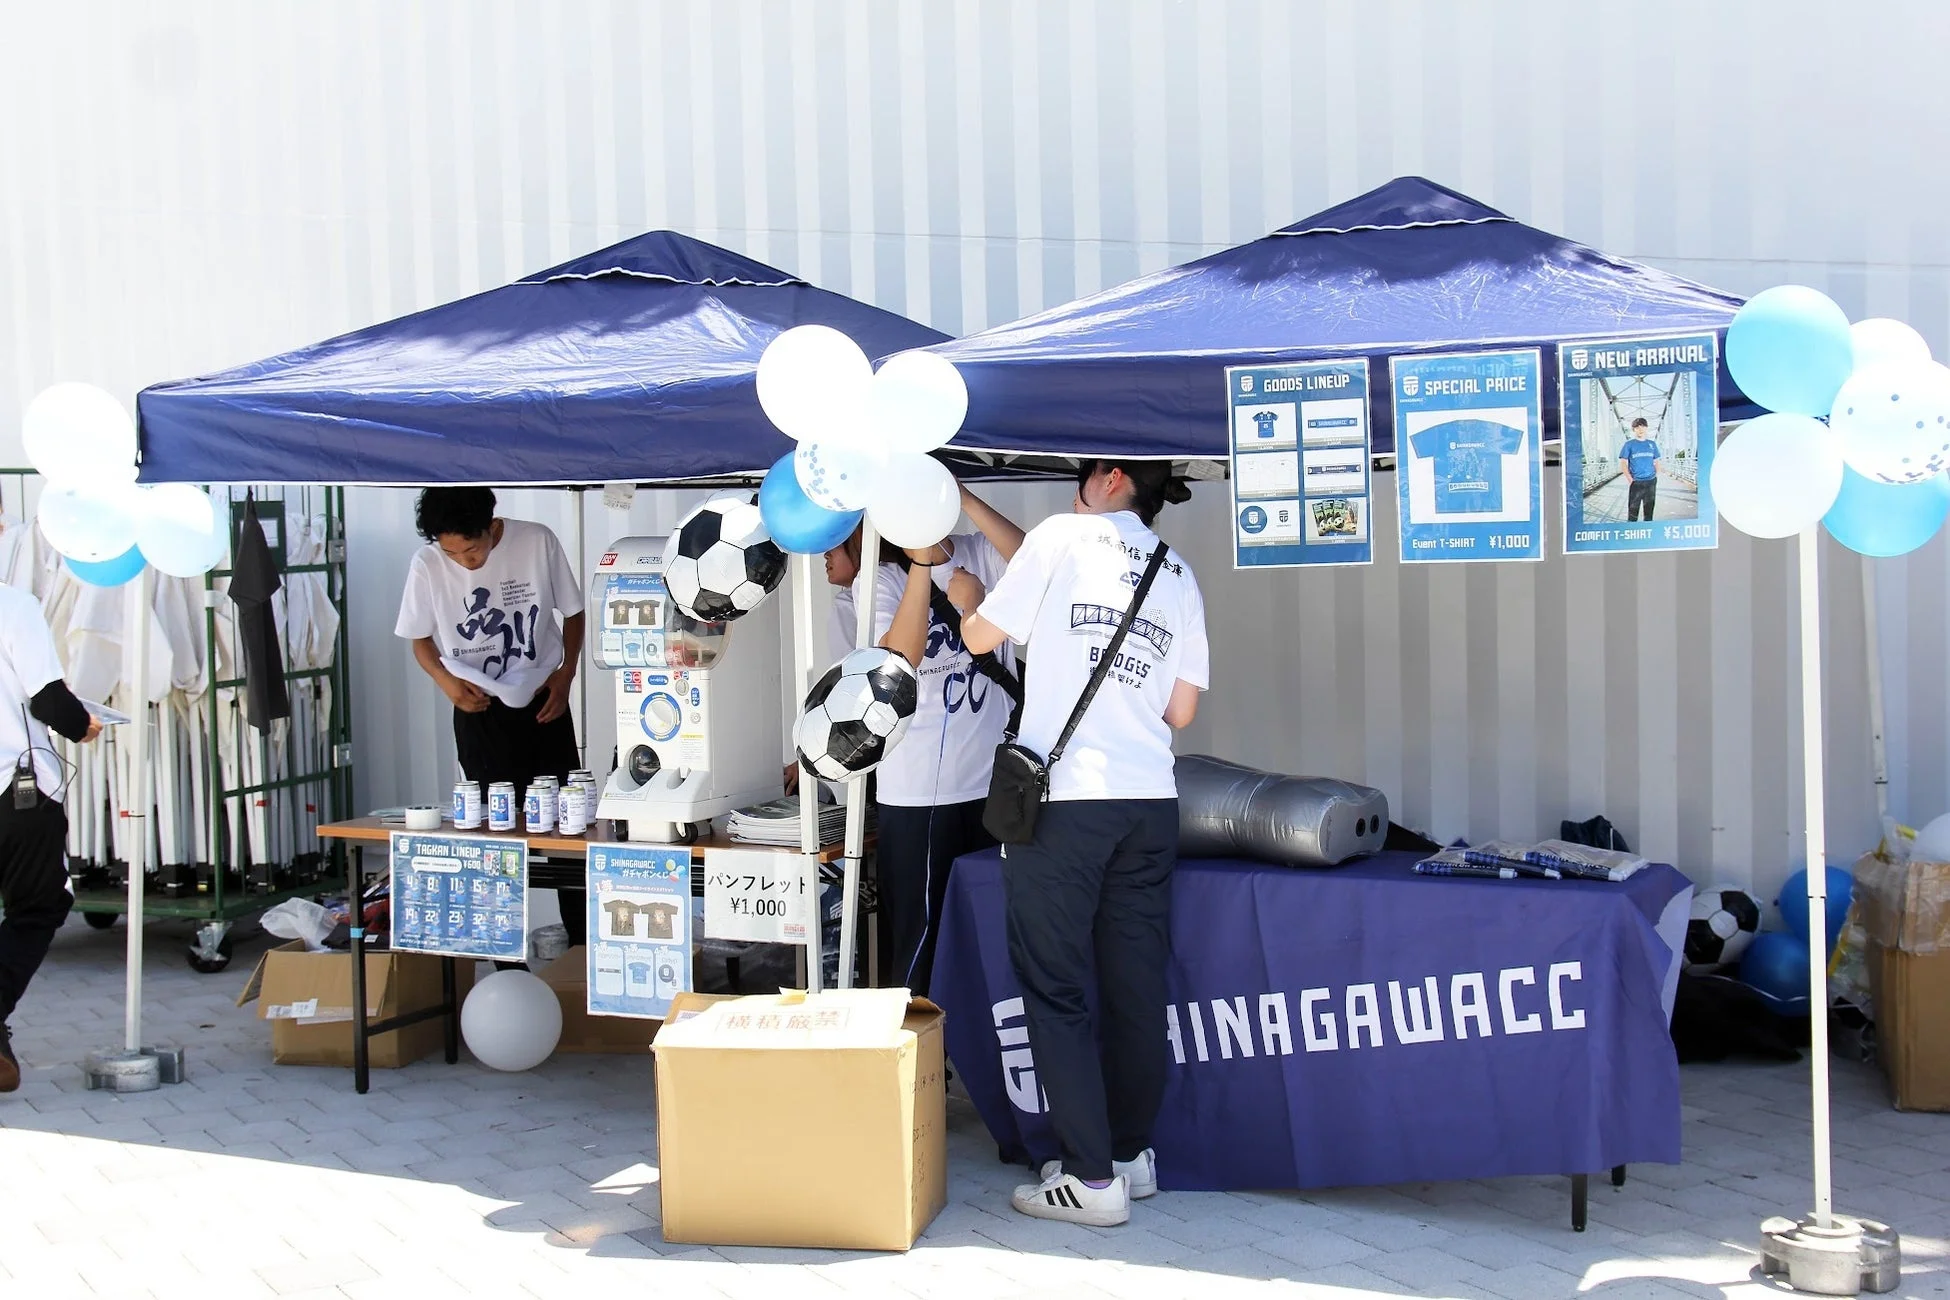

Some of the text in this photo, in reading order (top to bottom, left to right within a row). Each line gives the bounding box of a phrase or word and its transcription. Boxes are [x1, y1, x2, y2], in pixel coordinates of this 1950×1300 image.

[1595, 345, 1708, 369] NEW ARRIVAL
[1264, 374, 1350, 393] GOODS LINEUP
[1425, 376, 1526, 396] SPECIAL PRICE
[1575, 524, 1711, 542] COMFIT T-SHIRT ¥5,000
[1440, 537, 1475, 548] T-SHIRT
[1489, 534, 1530, 550] ¥1,000
[1090, 646, 1152, 679] BDGES
[416, 844, 481, 859] TAGKAN LINEUP
[610, 858, 656, 869] SHINAGAWACC
[406, 875, 413, 888] 4
[427, 877, 435, 891] 8
[450, 877, 458, 891] 11
[473, 879, 482, 893] 15
[708, 872, 806, 894] パンフレット
[730, 896, 787, 918] ¥1,000
[425, 910, 435, 922] 22
[449, 910, 460, 923] 23
[1166, 961, 1587, 1064] HINAGAWACC
